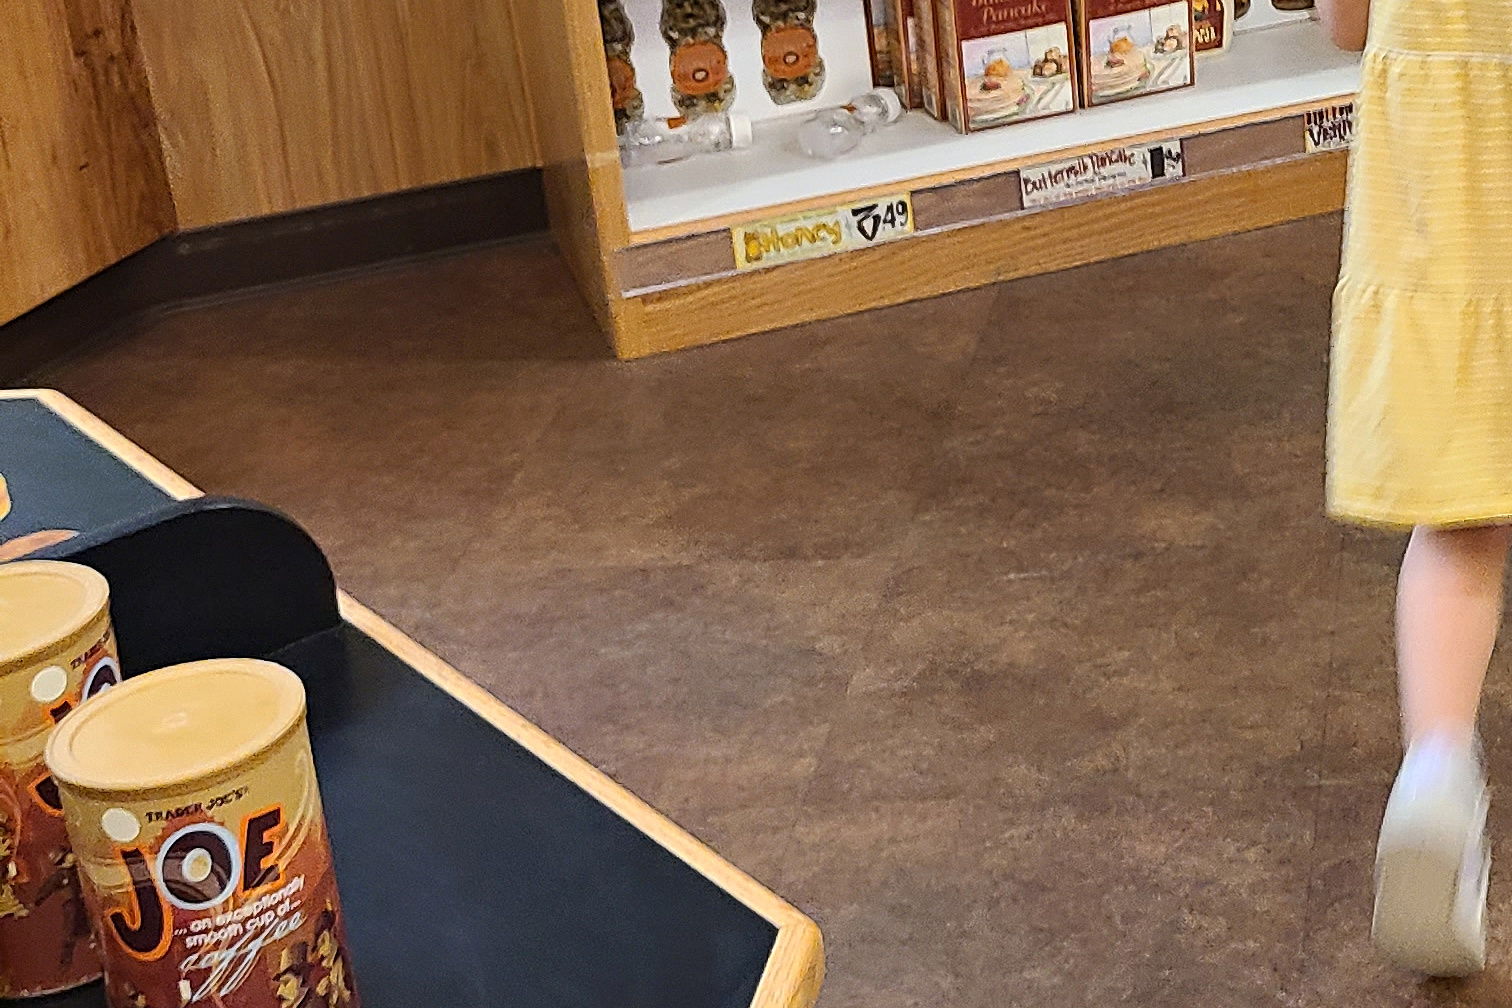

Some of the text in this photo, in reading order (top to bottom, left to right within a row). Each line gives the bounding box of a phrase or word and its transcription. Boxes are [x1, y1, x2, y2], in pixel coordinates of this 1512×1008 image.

[145, 802, 203, 823] TRADER
[108, 804, 284, 959] JOE
[215, 873, 305, 928] exceptional
[185, 921, 244, 949] smooth
[244, 909, 276, 934] cup
